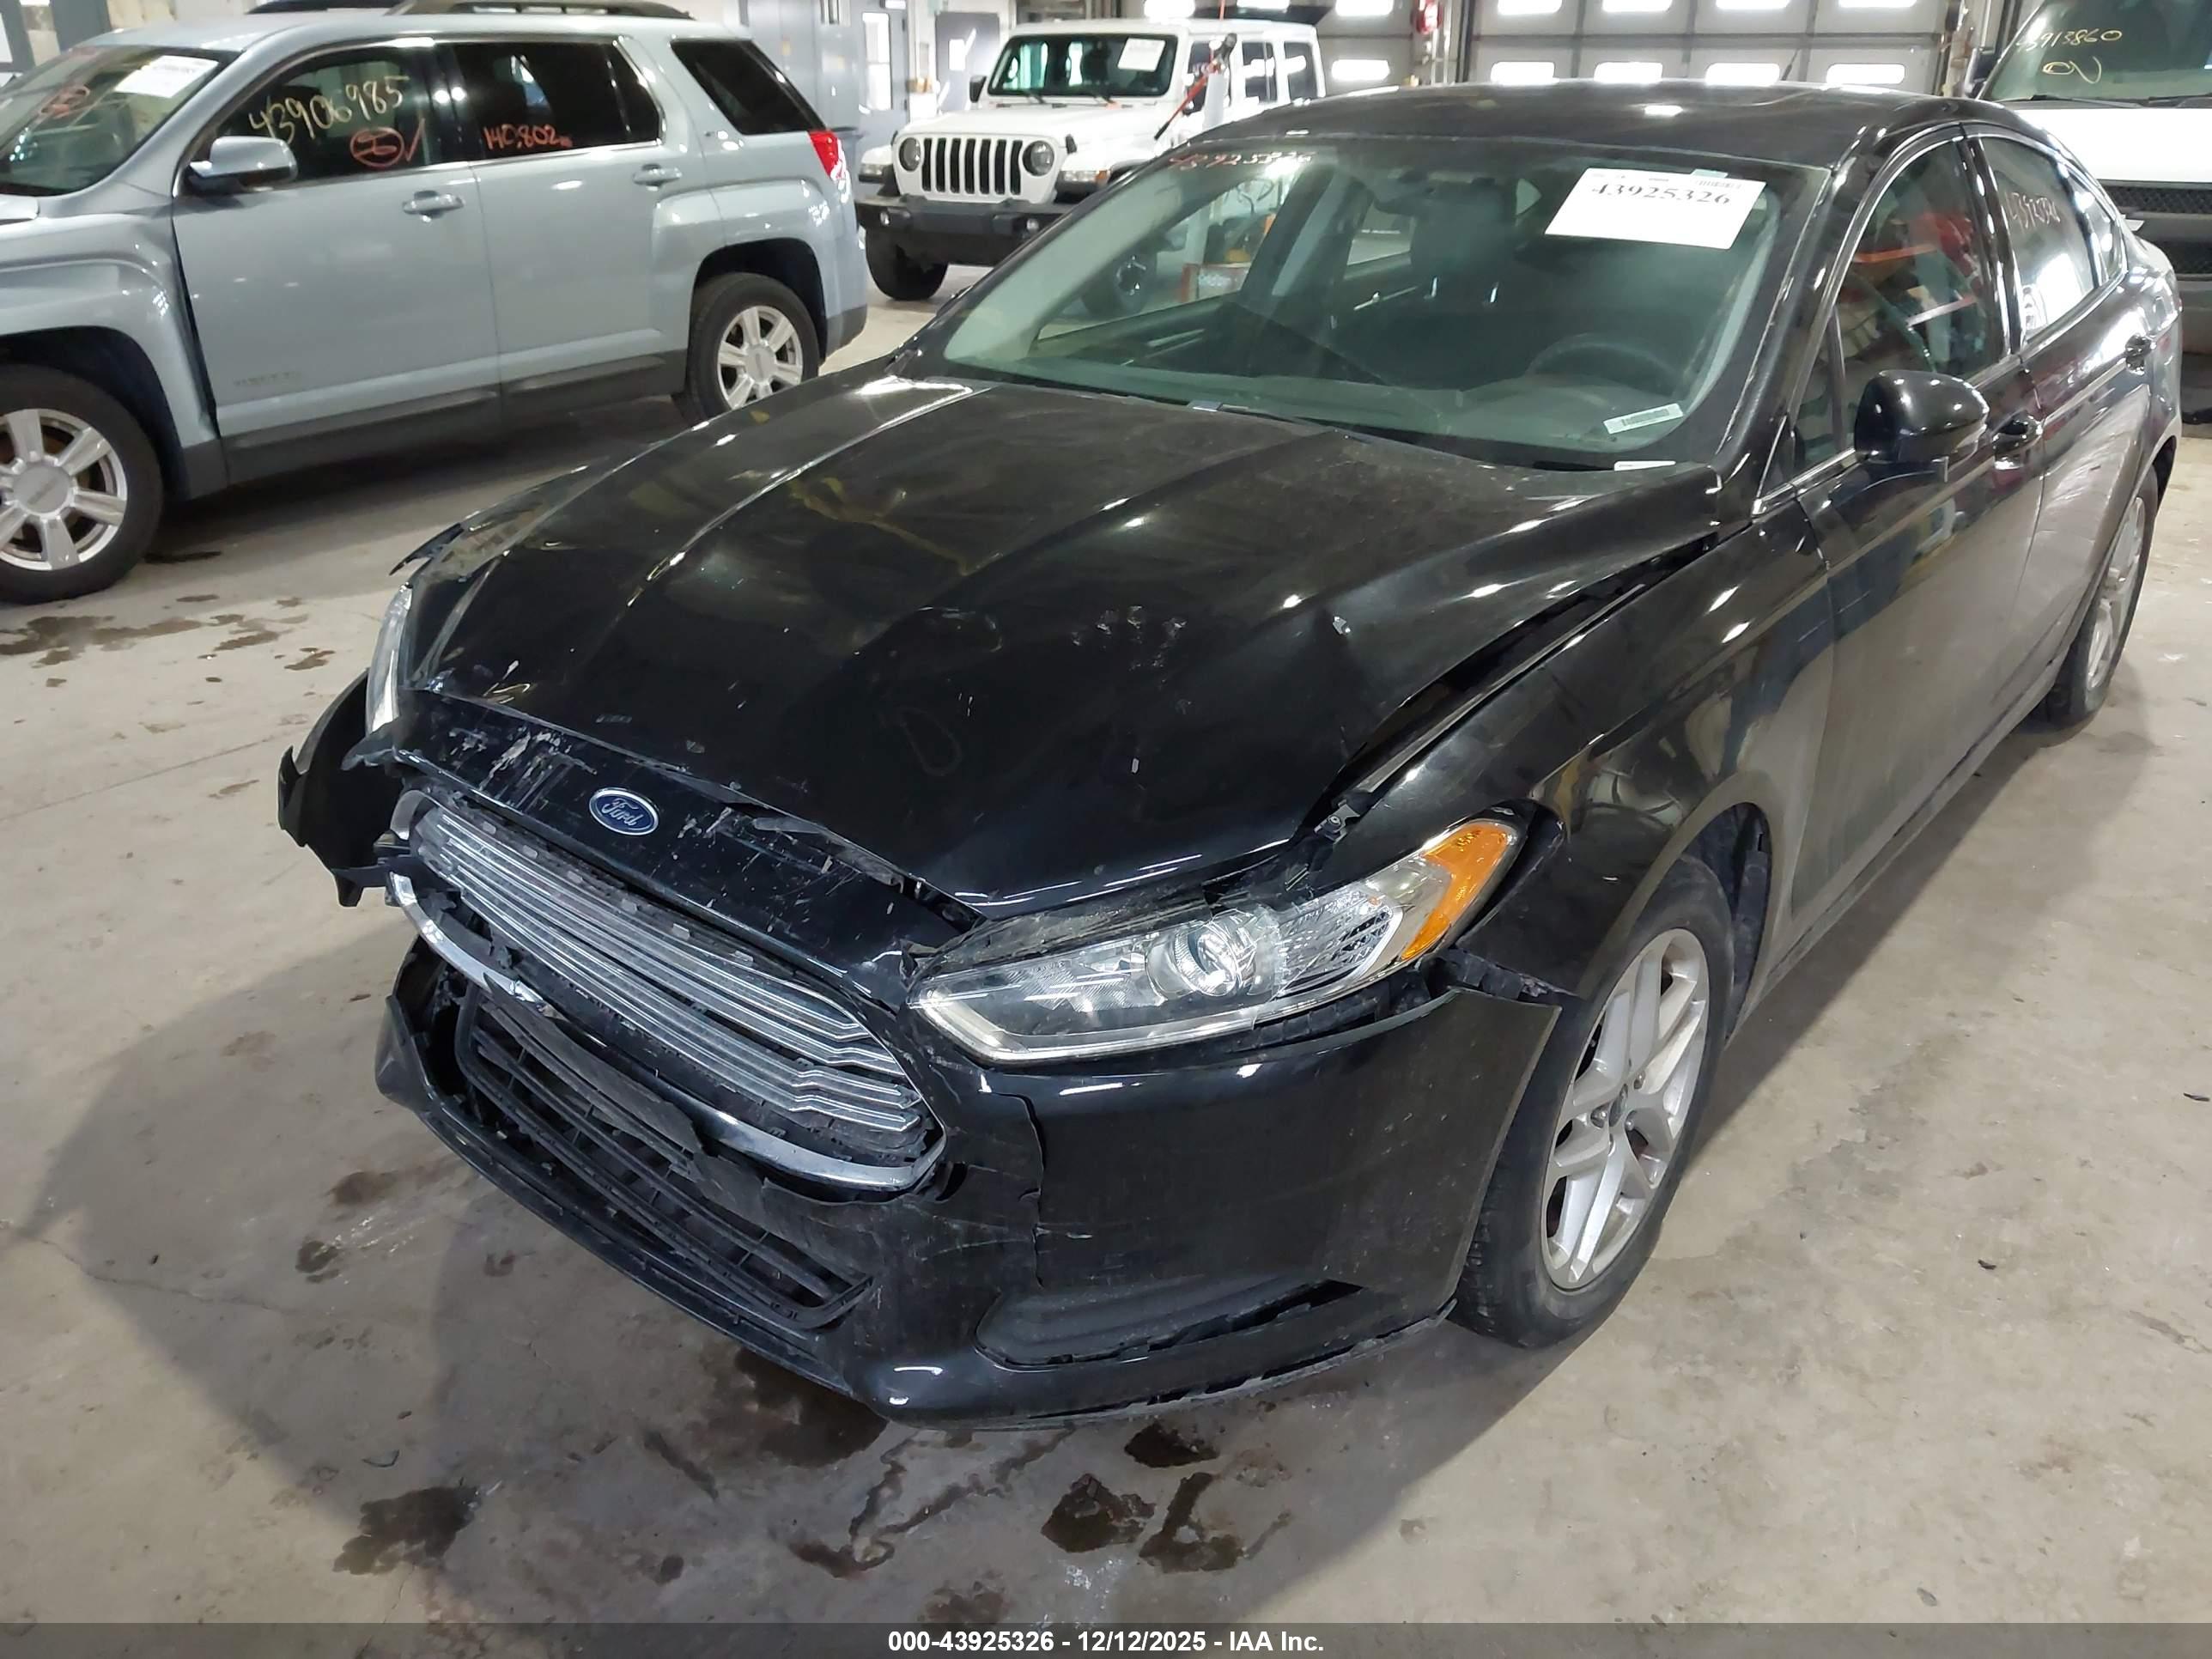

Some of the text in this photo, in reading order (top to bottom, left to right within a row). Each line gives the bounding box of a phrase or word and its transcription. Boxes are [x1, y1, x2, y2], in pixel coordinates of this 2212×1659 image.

[248, 76, 410, 144] 43906985
[1591, 183, 1731, 205] 43925326
[602, 799, 644, 826] Ford
